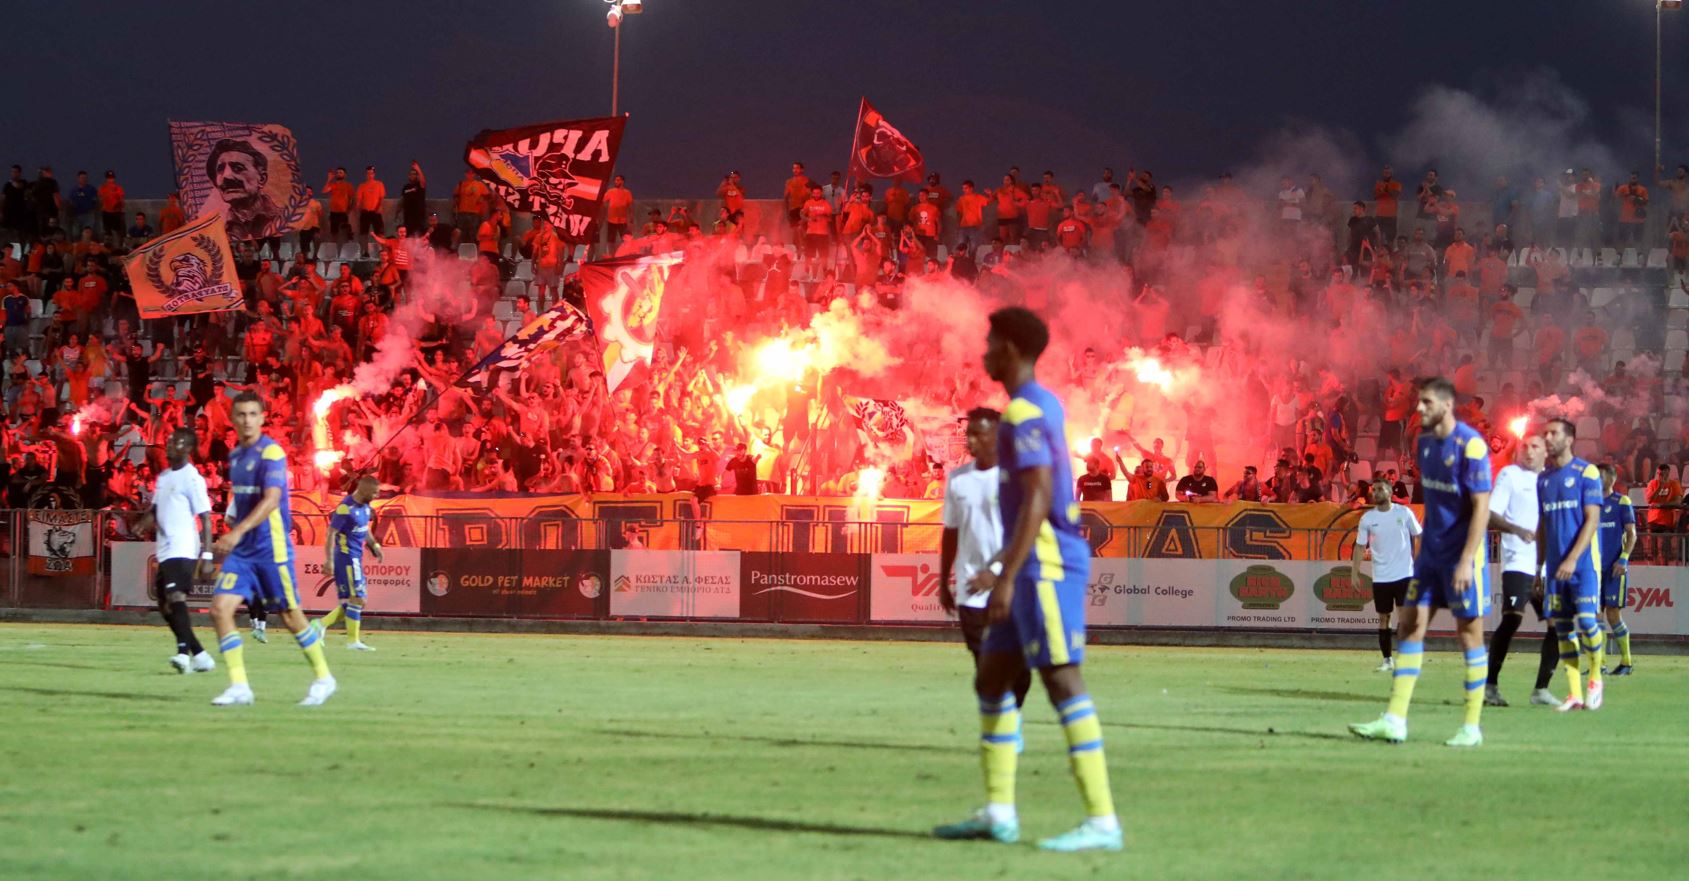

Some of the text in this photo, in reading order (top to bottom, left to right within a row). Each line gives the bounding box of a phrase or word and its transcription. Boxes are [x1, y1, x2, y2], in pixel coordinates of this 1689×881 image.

[460, 574, 571, 589] GOLD PET MARKET
[635, 574, 679, 584] ΚΩΣΤΑΣ
[694, 575, 731, 585] ΦΕΣΑΣ
[751, 570, 859, 587] Panstromasew
[1113, 585, 1194, 599] Global College
[1509, 596, 1518, 607] 7
[1627, 587, 1674, 613] SYM
[1310, 616, 1336, 624] PROMO
